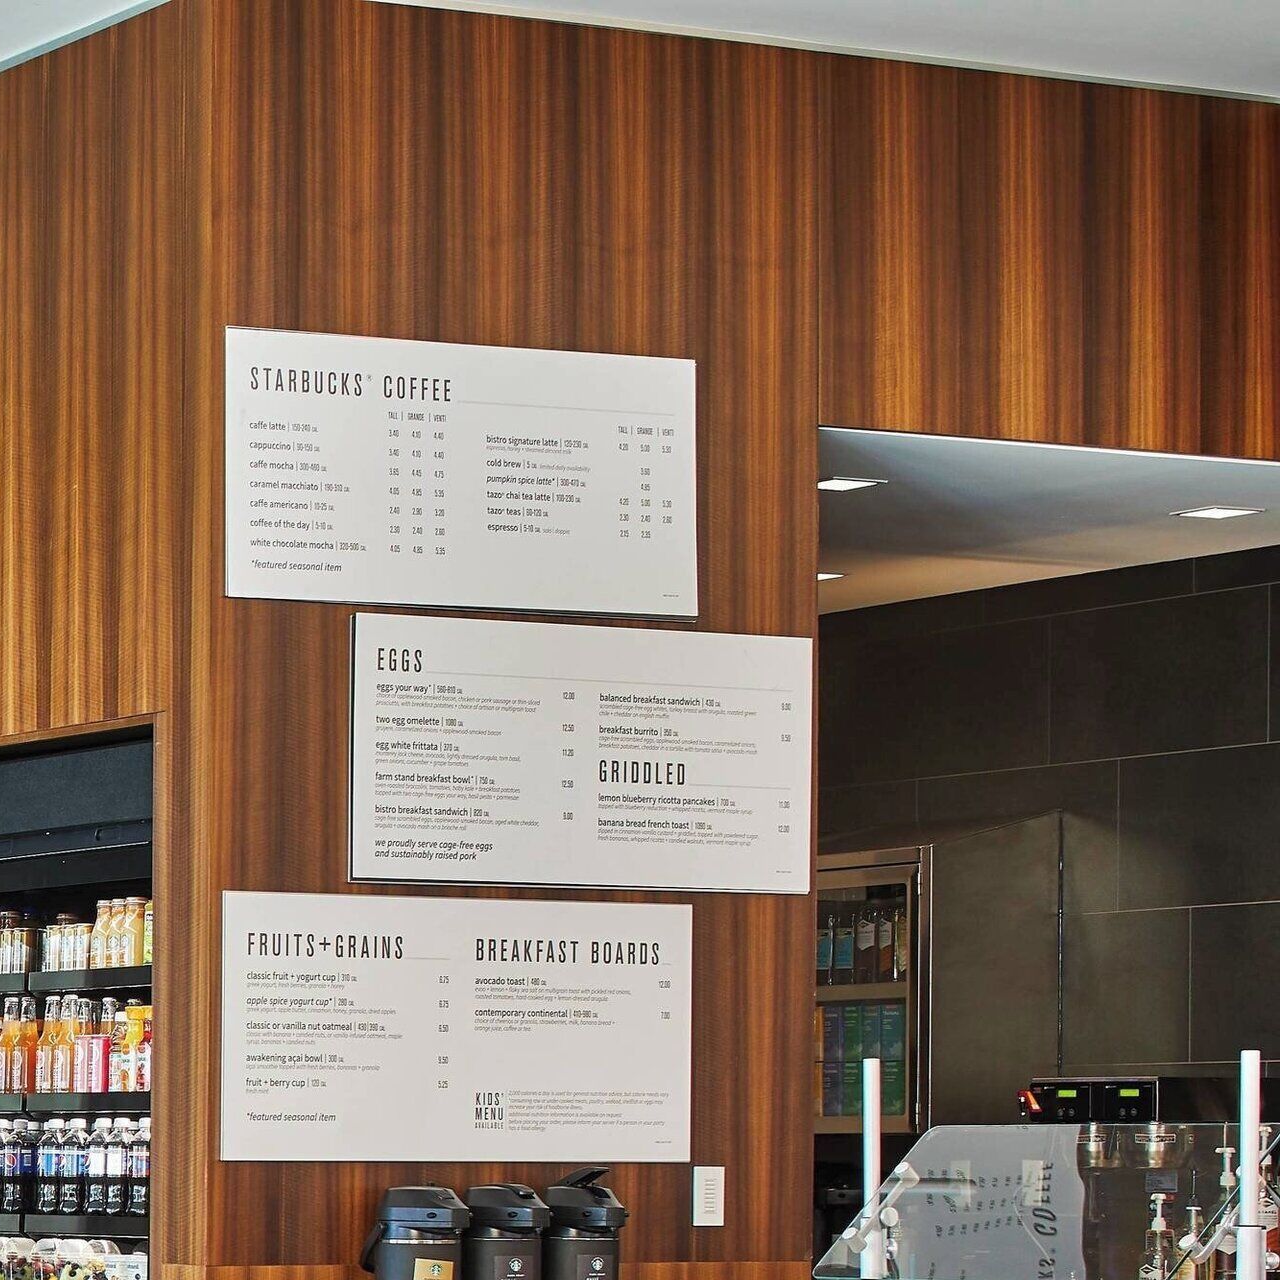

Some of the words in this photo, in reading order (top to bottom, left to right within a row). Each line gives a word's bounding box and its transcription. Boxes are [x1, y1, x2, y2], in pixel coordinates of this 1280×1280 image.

[383, 375, 451, 401] COFFEE
[249, 420, 267, 430] caffe
[268, 421, 286, 431] latte
[249, 440, 292, 454] cappuccino
[485, 434, 507, 445] bistro
[508, 435, 540, 449] signature
[541, 437, 558, 447] latte
[249, 459, 267, 469] caffe
[268, 460, 294, 471] mocha
[486, 458, 502, 468] cold
[503, 459, 522, 469] brew
[249, 479, 279, 489] caramel
[280, 480, 319, 491] macchiato
[485, 473, 516, 487] pumpkin
[517, 475, 535, 488] spice
[505, 490, 520, 500] chai
[521, 491, 534, 501] tea
[534, 492, 550, 502] latte
[249, 499, 268, 509] caffe
[269, 499, 308, 510] americano
[505, 506, 521, 516] teas
[249, 518, 273, 528] coffee
[273, 519, 282, 529] of
[282, 519, 295, 529] the
[296, 520, 310, 532] day
[487, 524, 518, 535] espresso
[249, 537, 270, 547] white
[272, 538, 307, 549] chocolate
[308, 540, 333, 550] mocha
[288, 561, 323, 571] seasonal
[324, 562, 342, 572] item
[377, 647, 423, 672] EGGS
[376, 684, 393, 694] eggs
[394, 684, 412, 695] your
[598, 692, 631, 703] balanced
[632, 694, 666, 705] breakfast
[666, 695, 700, 706] sandwich
[375, 714, 390, 724] two
[391, 717, 405, 727] egg
[406, 715, 439, 726] omelette
[598, 725, 632, 735] breakfast
[633, 726, 658, 737] burrito
[375, 741, 389, 752] egg
[390, 740, 411, 750] white
[412, 741, 438, 751] frittata
[375, 771, 392, 781] farm
[393, 772, 415, 782] stand
[416, 773, 451, 784] breakfast
[599, 760, 685, 785] GRIDDLED
[597, 792, 621, 803] lemon
[621, 793, 657, 807] blueberry
[657, 795, 681, 805] ricotta
[682, 796, 715, 809] pancakes
[374, 804, 396, 814] bistro
[397, 805, 432, 815] breakfast
[433, 806, 468, 816] sandwich
[597, 817, 624, 827] banana
[625, 818, 646, 828] bread
[647, 819, 670, 829] french
[671, 820, 689, 830] toast
[374, 839, 386, 847] we
[386, 838, 416, 851] proudly
[417, 841, 437, 849] serve
[438, 839, 474, 852] cage-free
[474, 843, 494, 853] eggs
[374, 848, 390, 858] and
[390, 849, 434, 862] sustainably
[434, 850, 458, 860] raised
[458, 851, 478, 863] pork
[247, 932, 403, 960] FRUITS+GRAINS
[475, 938, 579, 963] BREAKFAST
[591, 941, 660, 966] BOARDS
[246, 971, 271, 981] classic
[272, 971, 288, 981] fruit
[295, 972, 320, 984] yogurt
[321, 974, 336, 984] cup
[474, 976, 505, 986] avocado
[506, 976, 525, 986] toast
[246, 995, 268, 1008] apple
[269, 996, 288, 1008] spice
[288, 996, 314, 1008] yogurt
[474, 1007, 526, 1020] contemporary
[526, 1008, 567, 1018] continental
[245, 1020, 270, 1030] classic
[281, 1021, 306, 1030] vanilla
[307, 1021, 321, 1031] nut
[321, 1021, 352, 1031] oatmeal
[245, 1052, 286, 1065] awakening
[304, 1053, 323, 1063] bowl
[245, 1077, 262, 1087] fruit
[269, 1077, 291, 1090] berry
[291, 1080, 305, 1090] cup
[283, 1112, 317, 1122] seasonal
[318, 1113, 335, 1122] item
[475, 1107, 504, 1121] MENU
[474, 1122, 504, 1130] AVAILABLE
